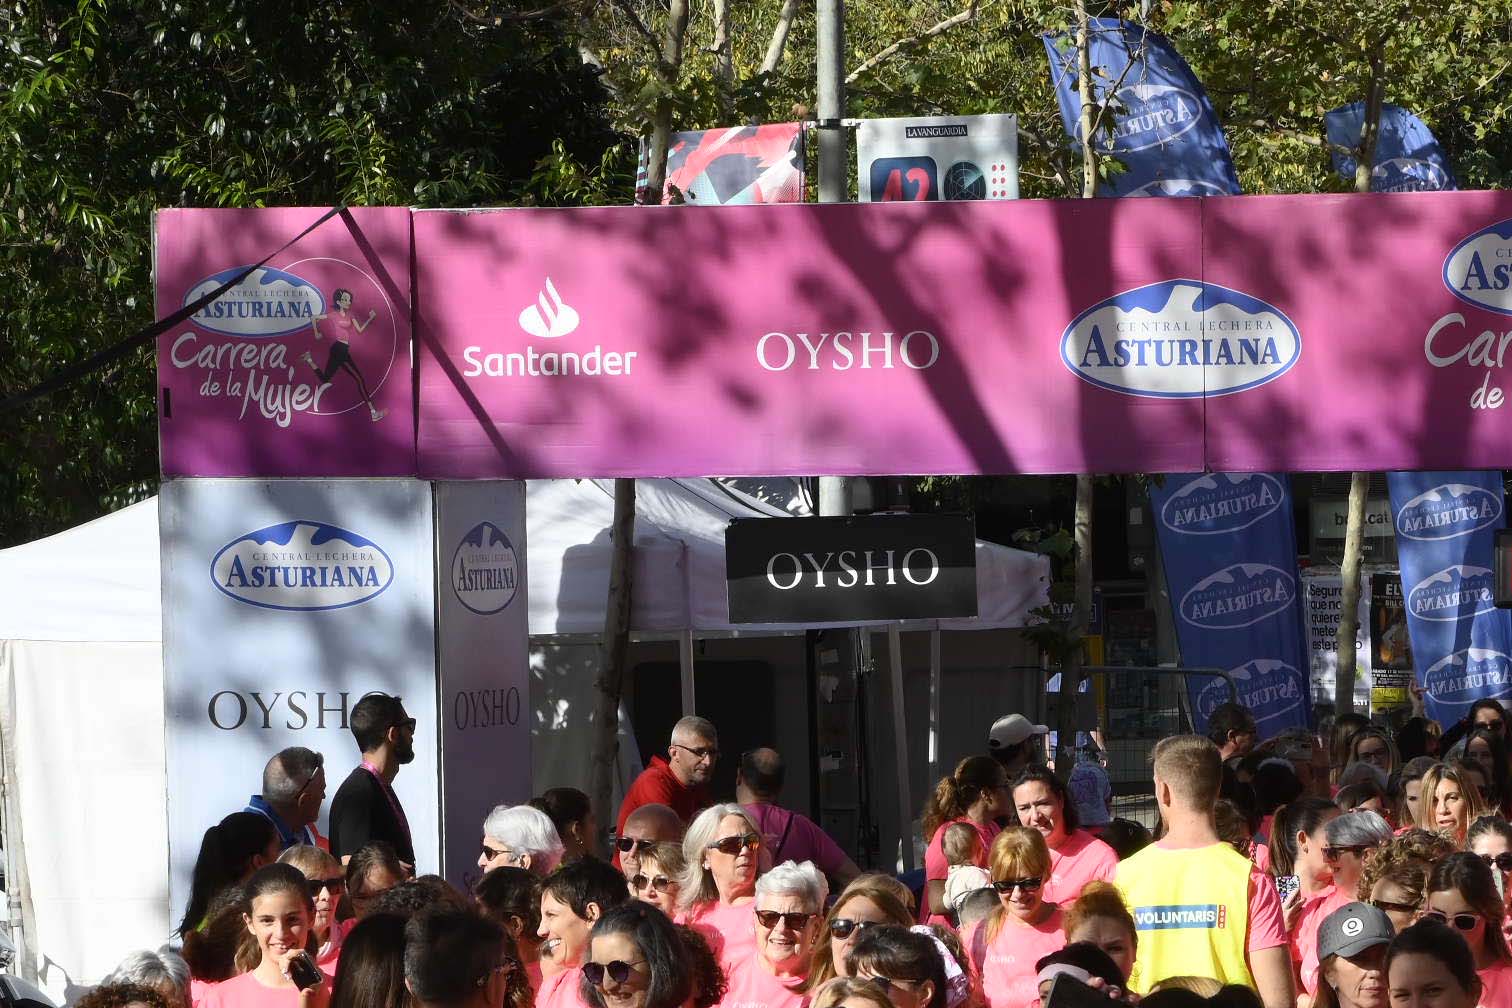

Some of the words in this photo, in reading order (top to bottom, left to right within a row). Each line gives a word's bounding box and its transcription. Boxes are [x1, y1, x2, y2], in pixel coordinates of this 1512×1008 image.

[1116, 320, 1191, 333] CENTRAL
[1199, 319, 1274, 332] LECHERA
[170, 332, 287, 369] Carrera
[463, 345, 638, 377] Santander
[756, 331, 940, 372] OYSHO
[1080, 325, 1282, 368] ASTURIANA
[200, 371, 221, 396] de
[227, 370, 242, 397] la
[239, 367, 333, 428] Mujer
[1470, 372, 1505, 409] de
[225, 554, 380, 588] ASTURIANA
[252, 552, 312, 562] CENTRAL
[316, 551, 374, 562] LECHERA
[766, 548, 939, 590] OYSHO
[457, 562, 518, 592] ASTURIANA
[208, 690, 397, 731] OYSH
[455, 686, 520, 731] OYSHO
[1136, 910, 1215, 925] VOLUNTARIS
